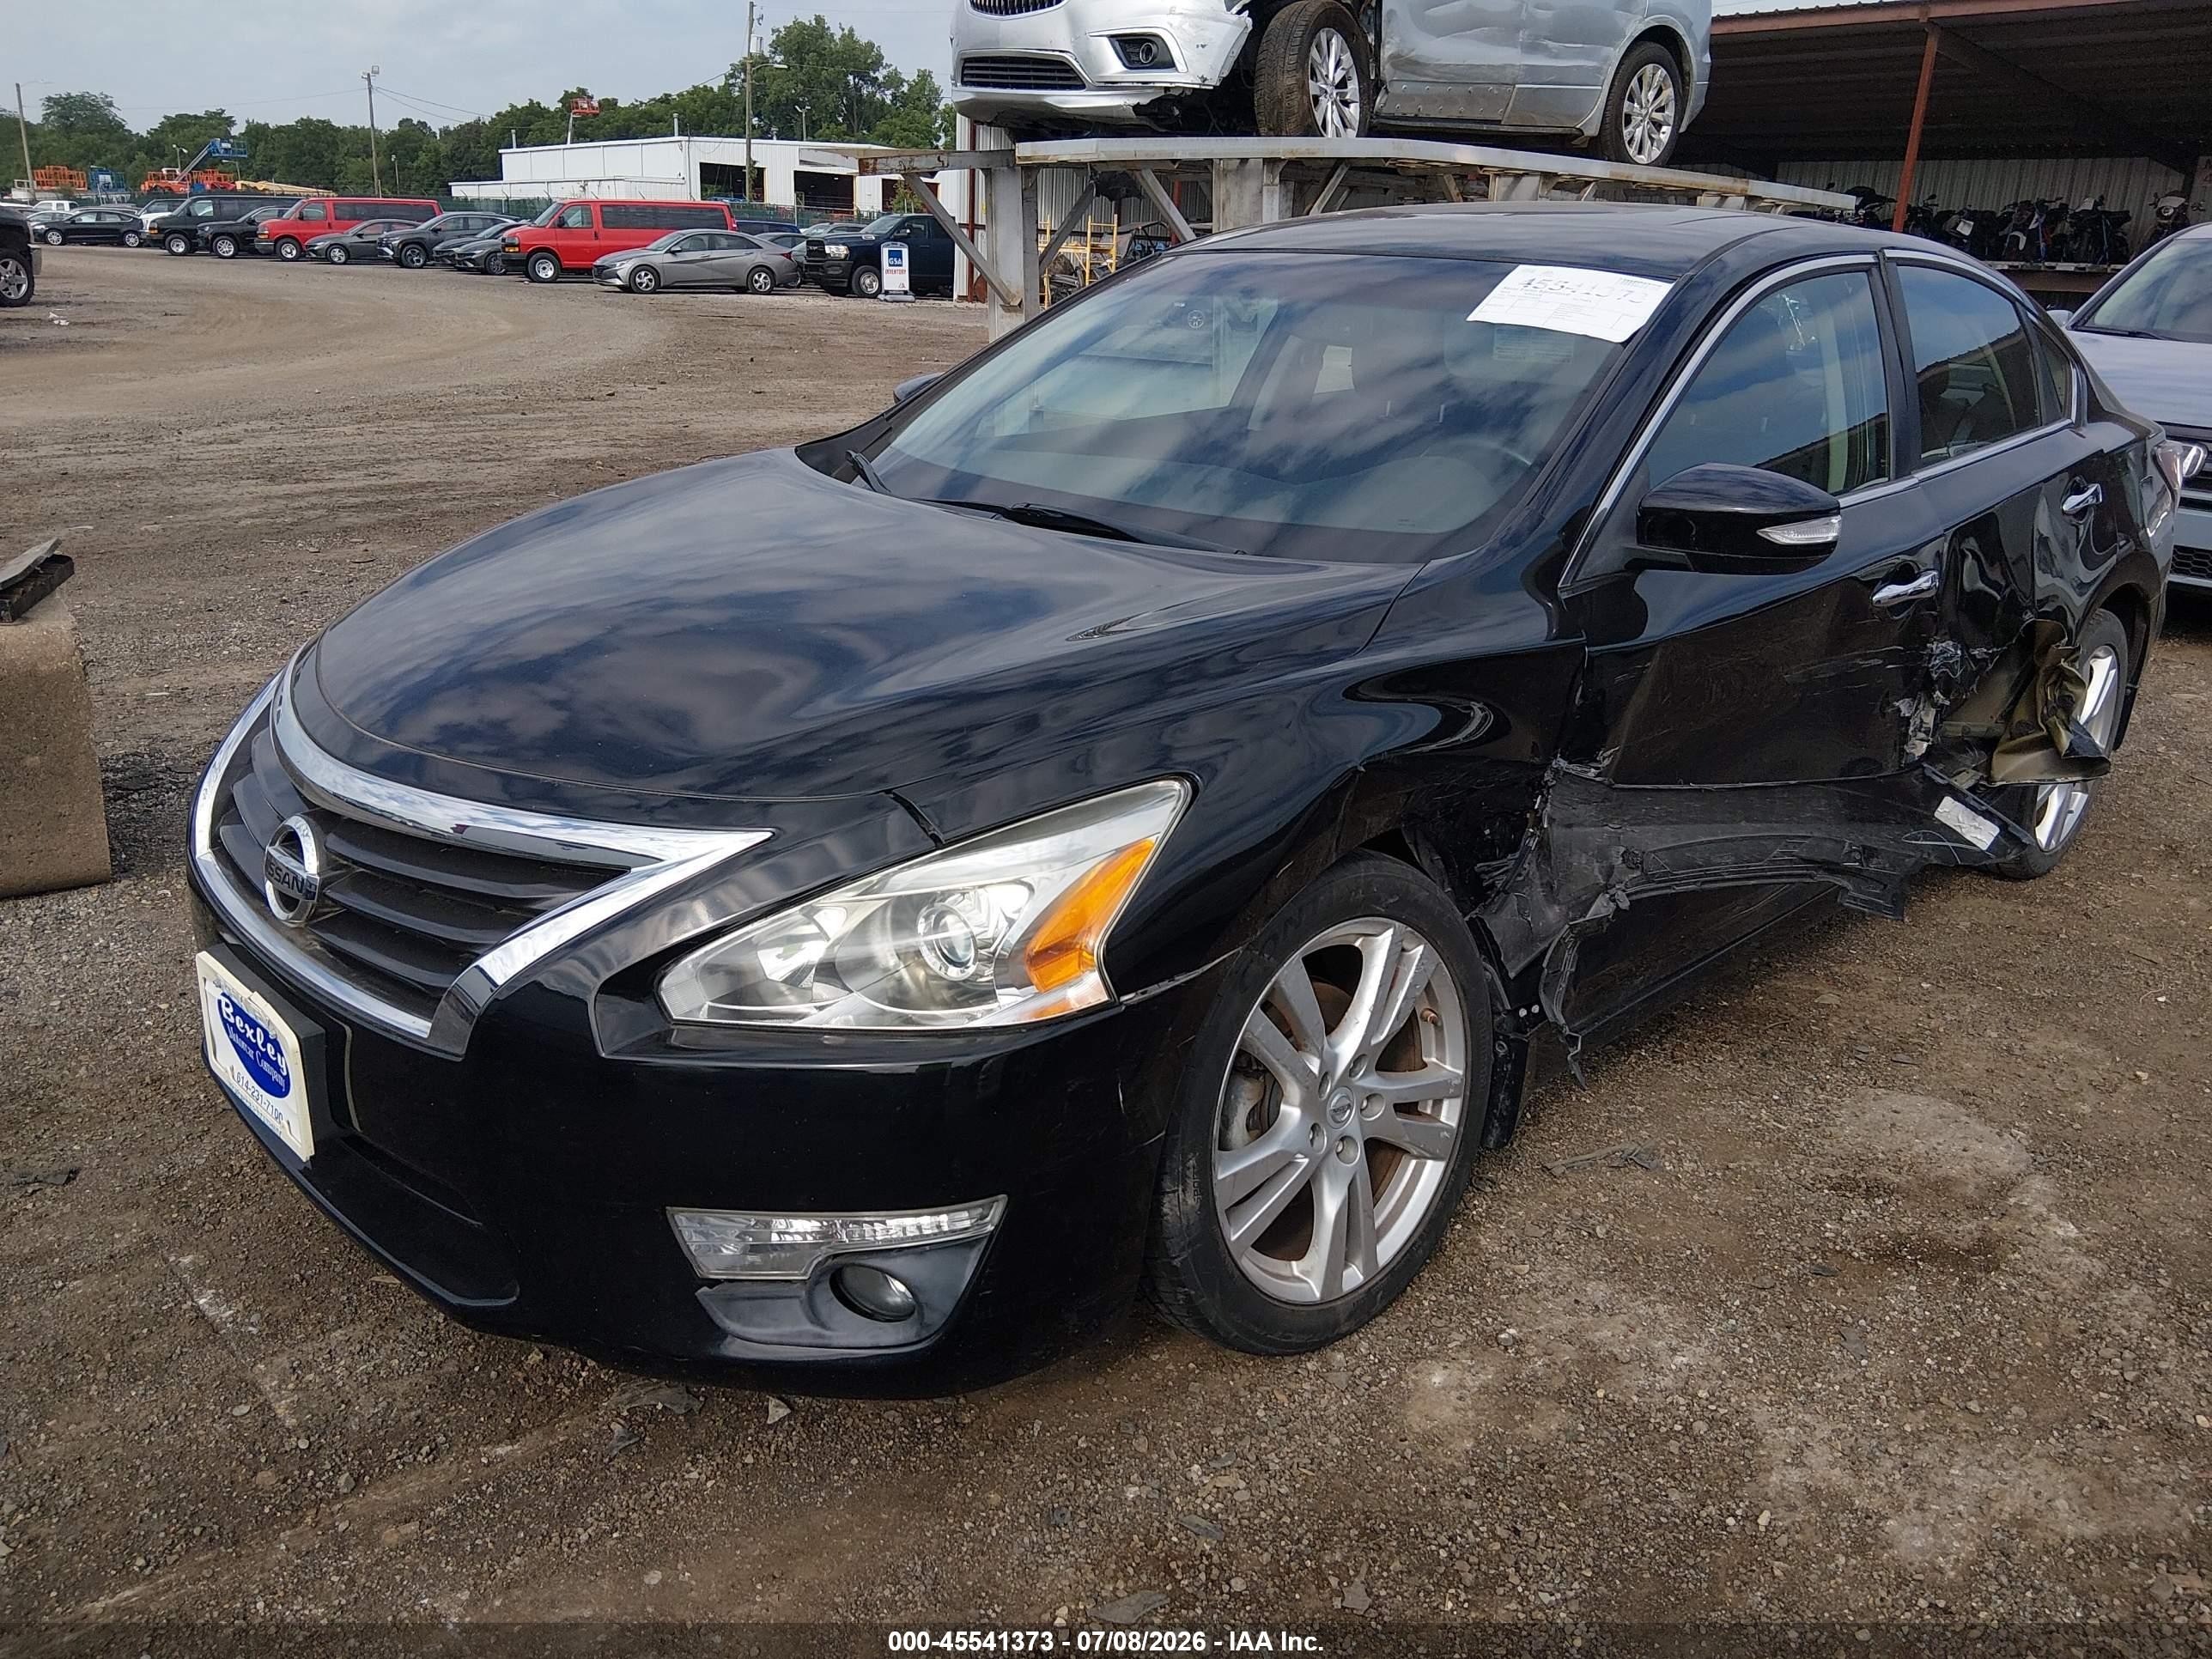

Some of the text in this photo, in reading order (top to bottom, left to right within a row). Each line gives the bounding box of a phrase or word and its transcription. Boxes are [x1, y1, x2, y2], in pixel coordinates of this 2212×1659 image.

[267, 862, 305, 895] SSAN
[219, 995, 287, 1077] Bexley
[256, 1050, 286, 1092] Company
[236, 1071, 283, 1125] 614-231-7100
